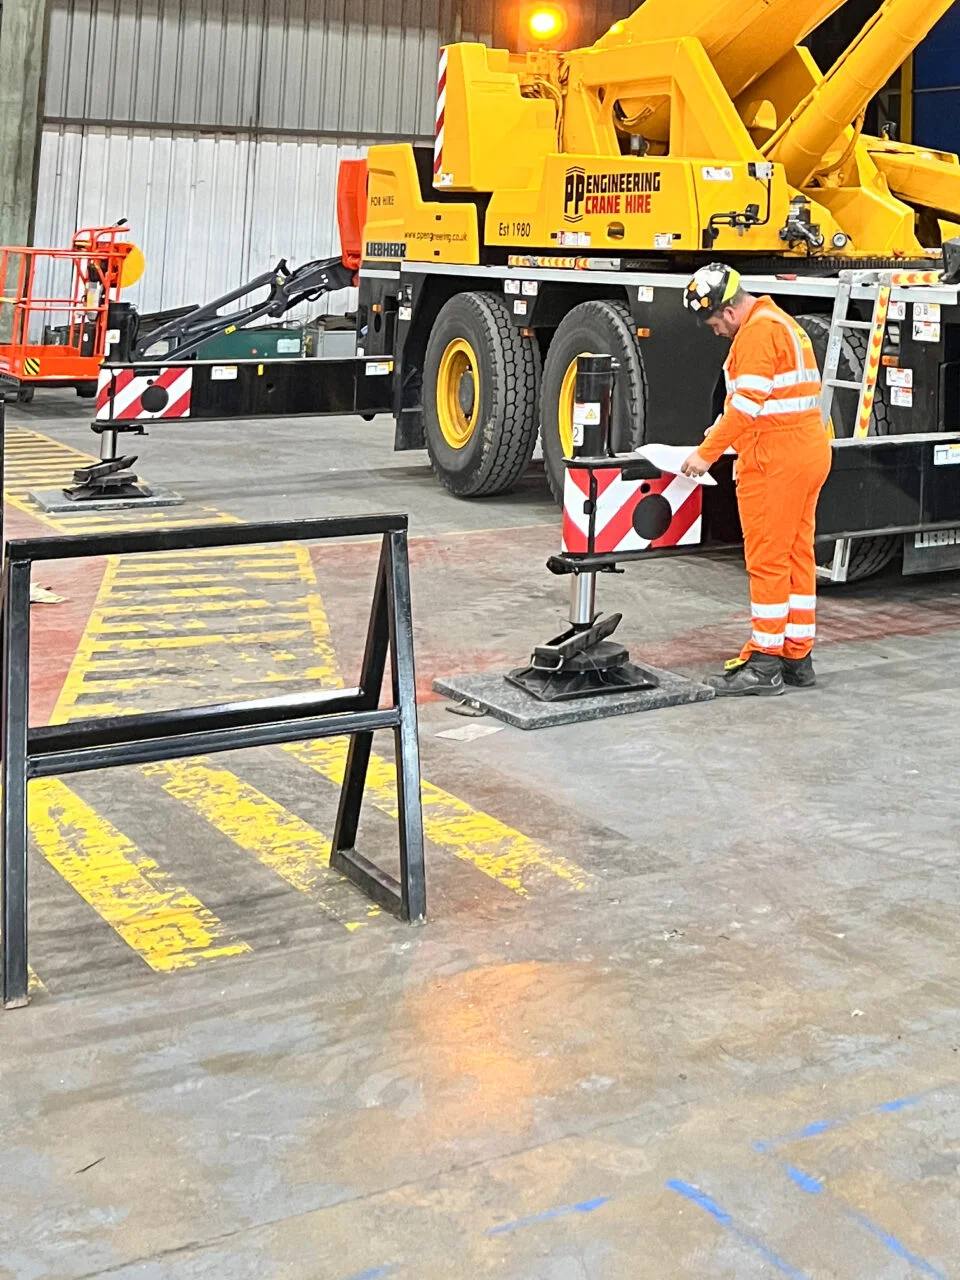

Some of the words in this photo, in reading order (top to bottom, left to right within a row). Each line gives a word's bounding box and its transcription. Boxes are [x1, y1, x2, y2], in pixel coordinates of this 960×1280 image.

[564, 173, 585, 215] PP
[586, 172, 661, 193] ENGINEERING
[585, 195, 621, 214] CRANE
[625, 194, 652, 214] HIRE
[499, 222, 510, 237] Est
[512, 222, 531, 238] 1980
[366, 242, 407, 258] LIEBHERR
